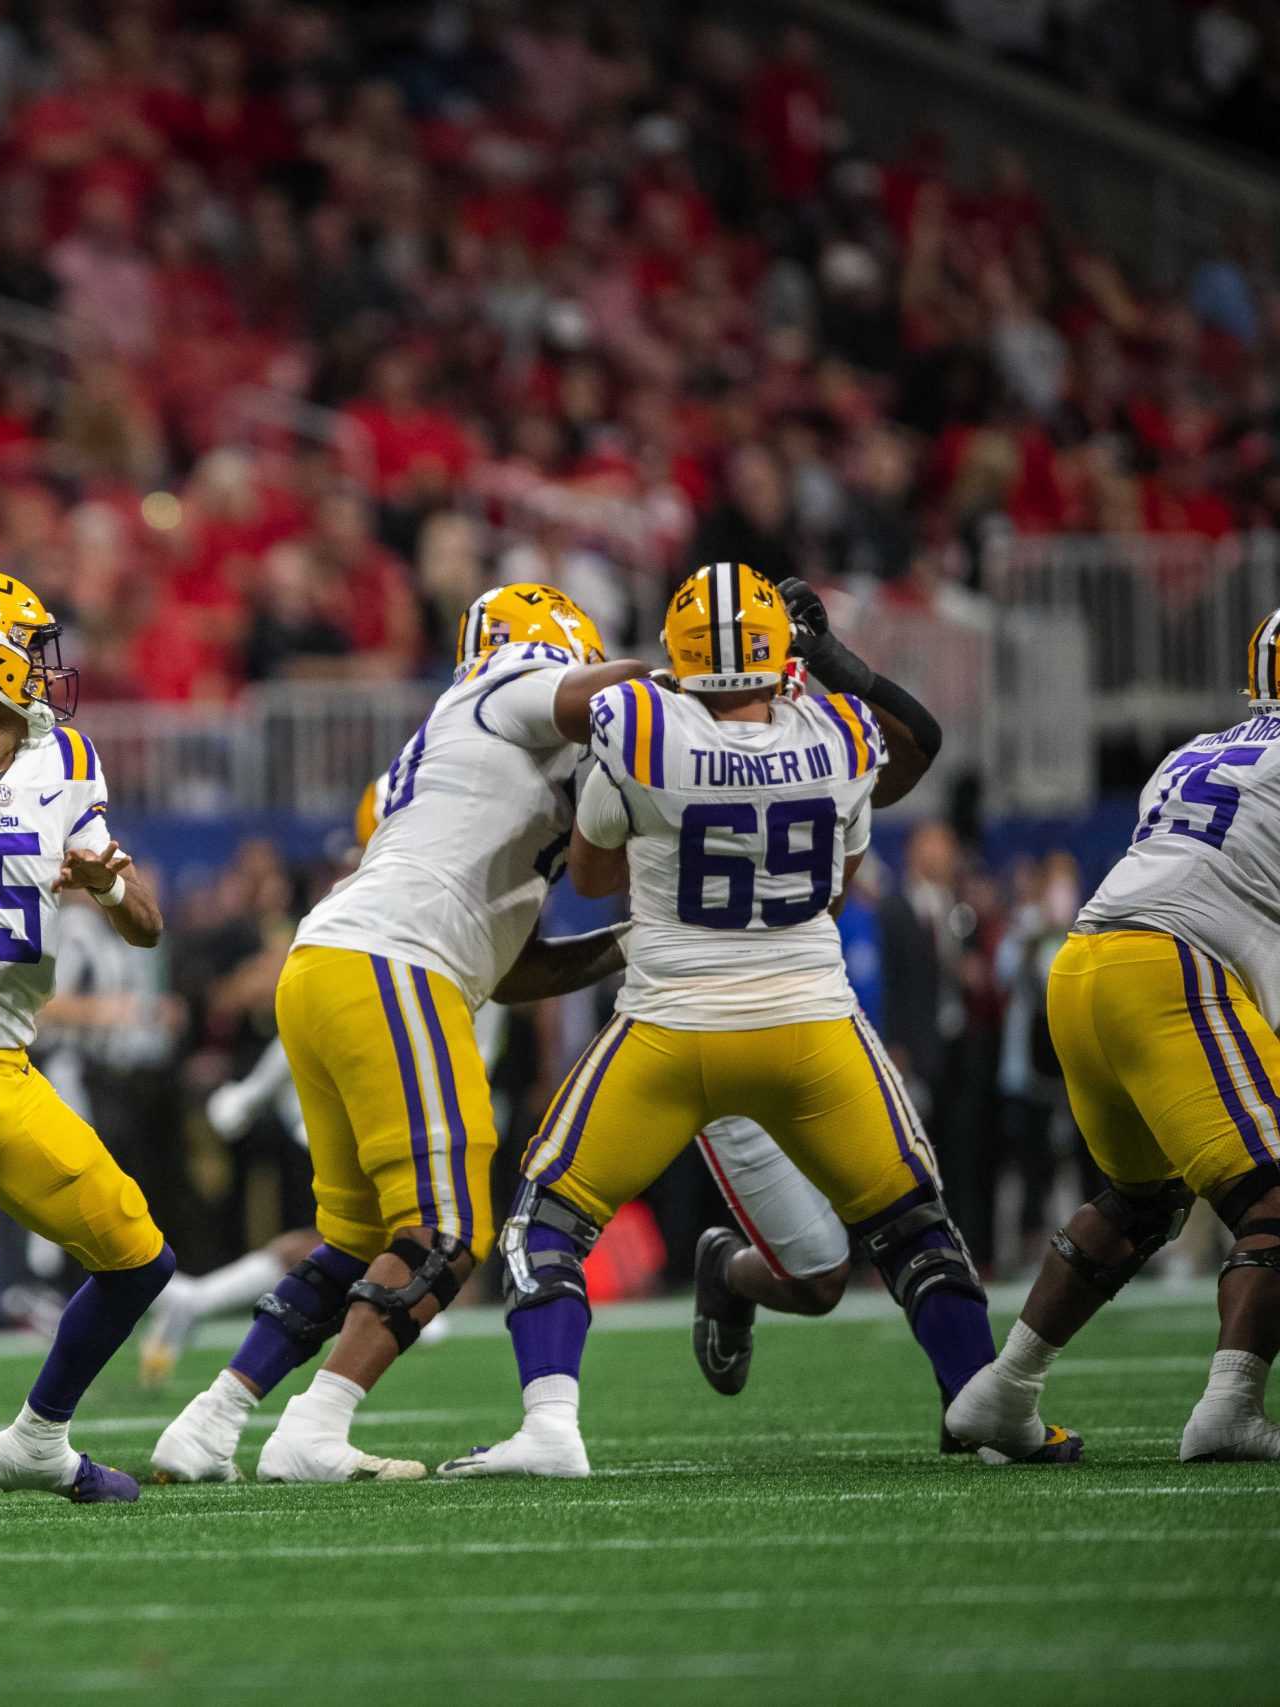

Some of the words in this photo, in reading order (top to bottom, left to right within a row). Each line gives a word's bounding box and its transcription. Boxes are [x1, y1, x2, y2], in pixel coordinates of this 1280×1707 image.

[700, 676, 762, 688] TIGERS
[690, 748, 802, 786] TURNER
[806, 743, 833, 779] III
[1135, 745, 1268, 851] 75
[677, 797, 838, 930] 69
